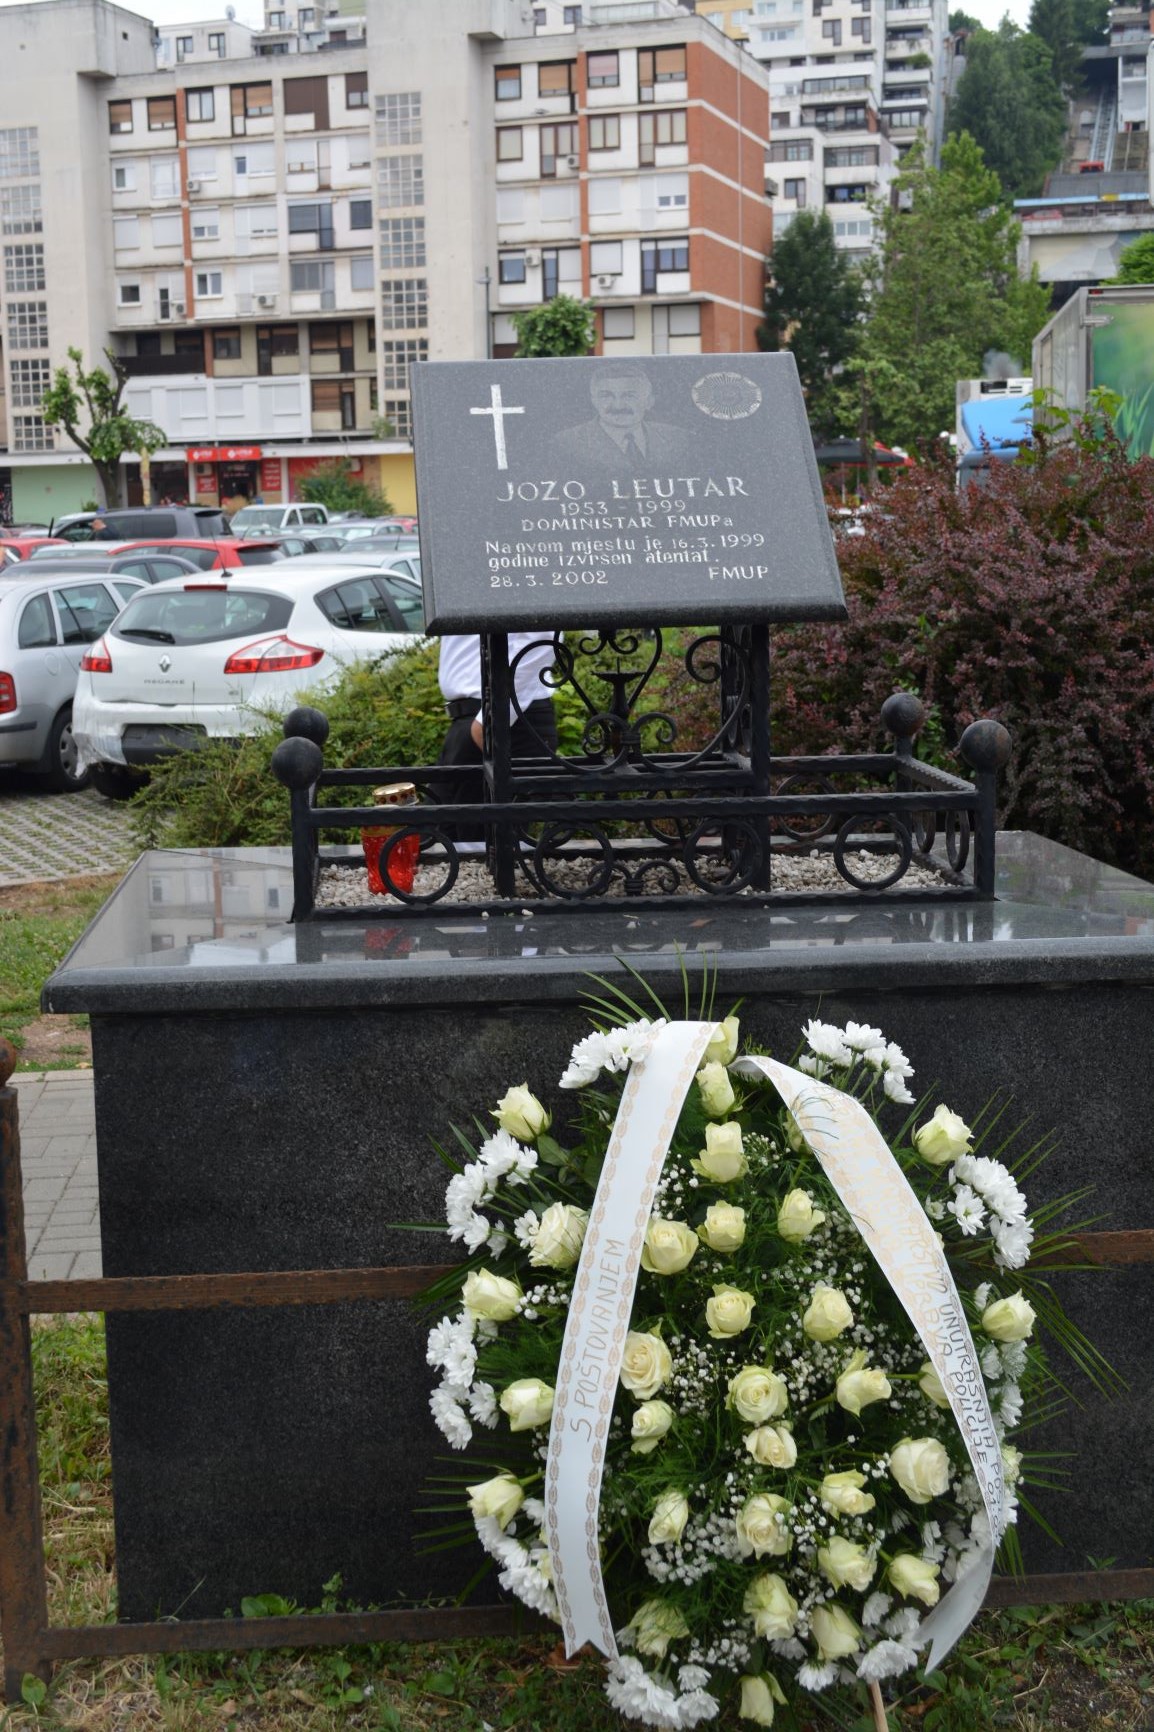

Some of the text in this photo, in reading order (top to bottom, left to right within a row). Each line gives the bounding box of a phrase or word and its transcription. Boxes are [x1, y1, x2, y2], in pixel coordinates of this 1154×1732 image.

[497, 476, 750, 502] JOZO LEUTAR
[560, 501, 608, 516] 1953
[637, 499, 687, 514] 1999
[521, 513, 734, 532] DOMINISTAR FMUPa
[571, 536, 636, 555] mjestu
[643, 535, 662, 552] je
[488, 554, 549, 572] godine
[708, 565, 769, 581] FMUP
[569, 1238, 625, 1443] S POŠTOVANJEM
[950, 1370, 988, 1464] POLICIJE
